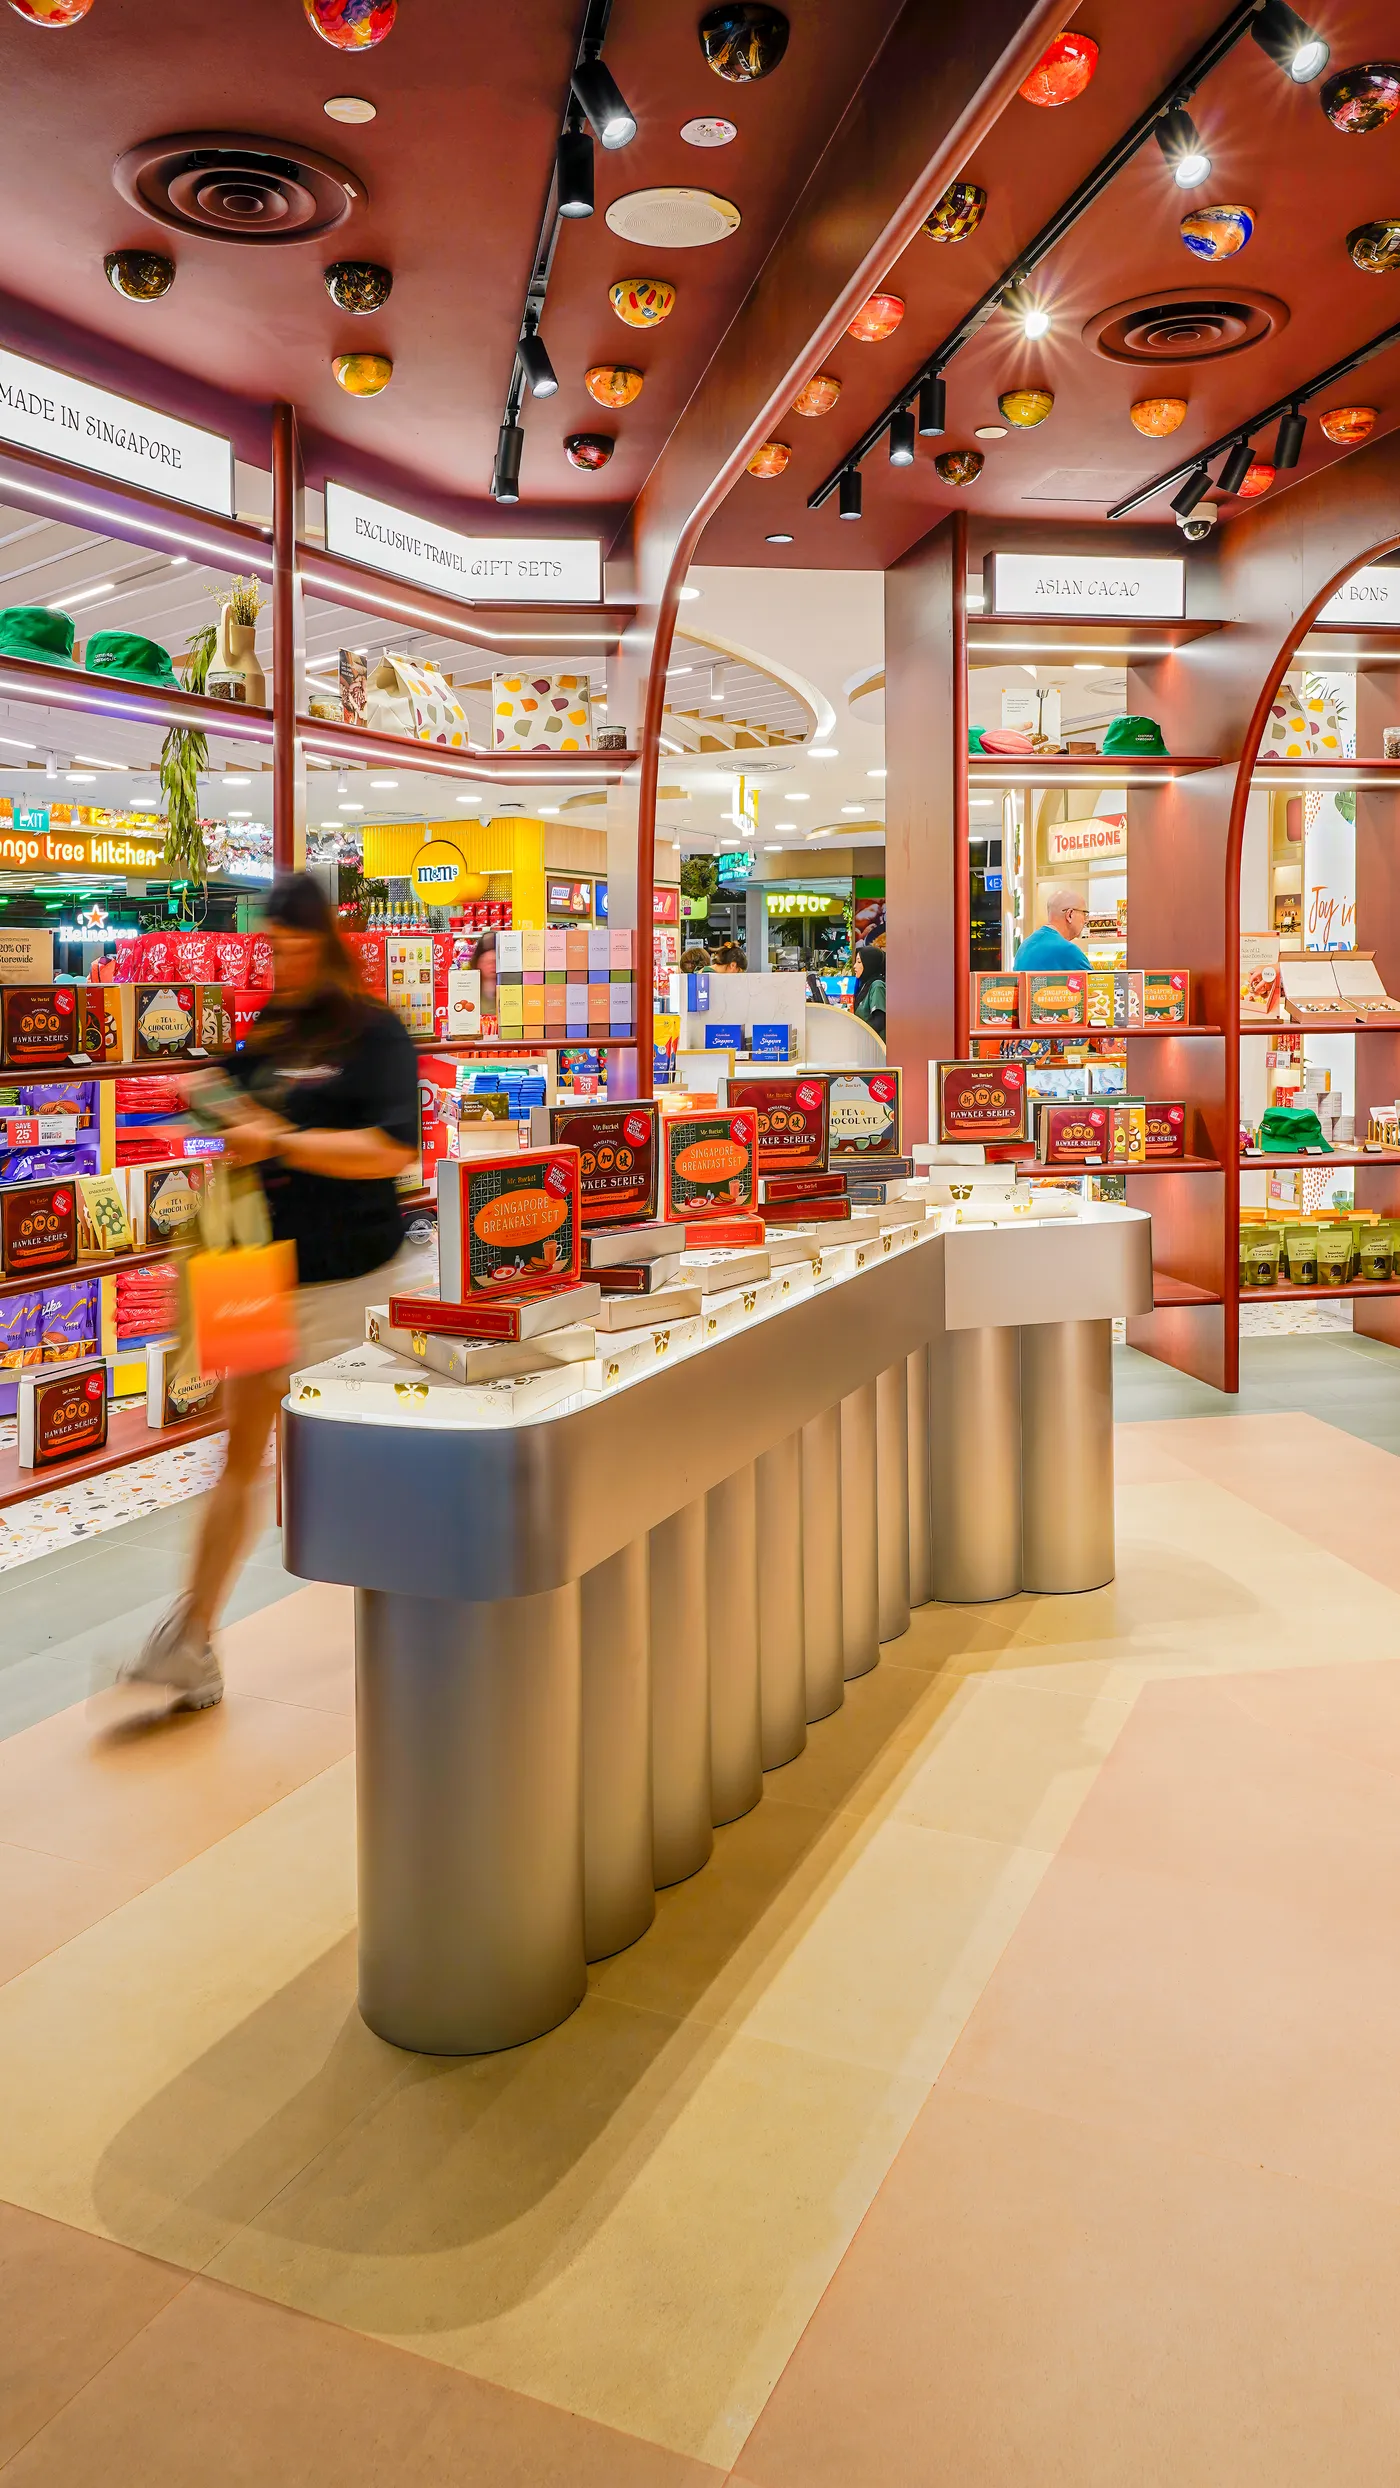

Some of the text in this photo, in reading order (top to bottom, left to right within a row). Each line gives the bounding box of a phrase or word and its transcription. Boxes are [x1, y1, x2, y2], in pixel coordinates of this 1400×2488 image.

[0, 382, 182, 469] MADE IN SINGAPORE
[355, 516, 562, 577] EXCLUSIVE TRAVEL GIFT SETS
[1035, 579, 1140, 597] ASIAN CACAO
[1350, 586, 1389, 602] BONS
[1055, 830, 1120, 853] TOBLERONE
[0, 835, 157, 867] ngo tree kitchen
[1308, 885, 1356, 944] Joy in
[59, 926, 138, 942] Heineken
[15, 944, 31, 954] OFF
[218, 944, 243, 960] KitKat
[235, 1010, 262, 1024] ave
[147, 1023, 184, 1032] CHOCOLATE
[12, 1034, 69, 1043] HAWKER SERIES
[712, 1037, 734, 1045] Singapore
[760, 1037, 782, 1045] Singapore
[840, 1108, 859, 1117] TEA
[950, 1109, 1016, 1119] HAWKER SERIES
[15, 1122, 31, 1130] SAVE
[602, 1123, 620, 1131] Bucket
[831, 1117, 878, 1125] OCOLATE
[758, 1135, 817, 1145] WKER SERIES
[690, 1146, 734, 1159] SINGAPORE
[581, 1151, 629, 1172] 新加坡
[682, 1156, 742, 1172] BREAKFAST SET
[507, 1174, 537, 1185] Mr. Bucket
[581, 1174, 646, 1189] WKER SERIES
[158, 1203, 193, 1216] CHOCOLATE
[493, 1196, 549, 1217] SINGAPORE
[483, 1209, 560, 1234] BREAKFAST SET
[12, 1232, 68, 1249] HAWKER SERIES
[41, 1300, 63, 1316] ilka
[177, 1379, 213, 1395] CHOCOLATE
[44, 1416, 99, 1439] HAWKER SERIES
